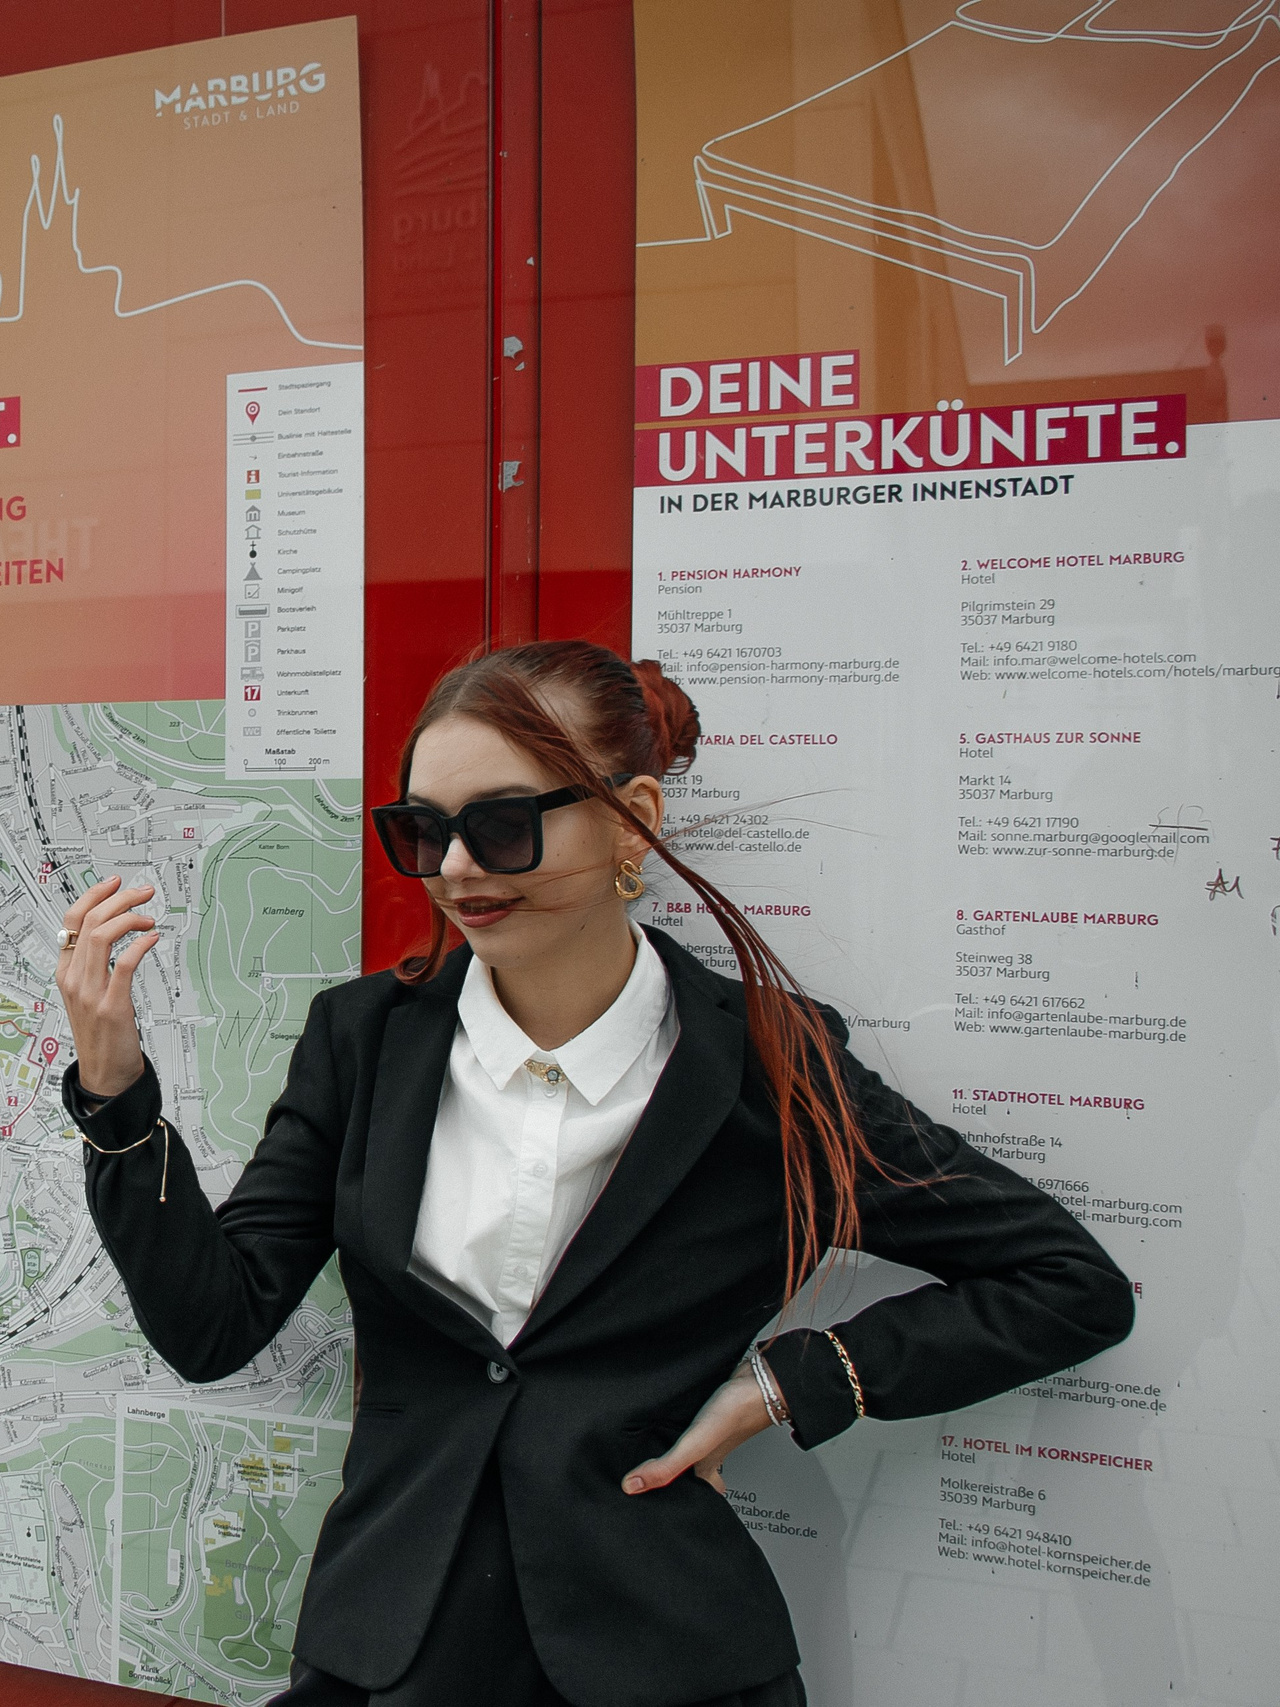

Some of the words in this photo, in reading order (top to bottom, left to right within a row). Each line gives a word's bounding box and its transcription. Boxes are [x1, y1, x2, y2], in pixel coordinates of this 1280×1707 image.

[155, 62, 326, 118] MARBURG
[184, 112, 230, 130] STADT
[239, 111, 247, 121] &
[256, 101, 299, 119] LAND
[278, 380, 331, 391] Stadtspaziergang
[660, 354, 854, 418] DEINE
[317, 428, 351, 436] Haltestelle
[658, 399, 1179, 481] UNTERKÜNFTE.
[278, 469, 338, 478] Tourist-Information
[278, 487, 343, 498] Universitätsgebäude
[660, 495, 682, 514] IN
[692, 492, 738, 512] DER
[748, 485, 902, 510] MARBURGER
[912, 475, 1074, 500] INNENSTADT
[278, 528, 316, 536] Schutzhütte
[961, 560, 971, 571] 2.
[977, 557, 1051, 569] WELCOME
[1056, 555, 1104, 567] HOTEL
[1109, 552, 1184, 565] MARBURG
[278, 566, 321, 575] Campingplatz
[658, 572, 666, 581] 1.
[671, 569, 728, 581] PENSION
[733, 566, 801, 579] HARMONY
[962, 573, 995, 584] Hotel
[277, 586, 303, 595] Minigolf
[658, 585, 702, 594] Pension
[277, 605, 316, 613] Bootsverleih
[961, 601, 1035, 614] Pilgrimstein
[1040, 599, 1055, 610] 29
[658, 610, 724, 621] Mühltreppe
[961, 615, 997, 626] 35037
[1002, 613, 1055, 626] Marburg
[658, 623, 690, 633] 35037
[694, 622, 742, 634] Marburg
[989, 642, 1011, 652] +49
[1016, 641, 1043, 652] 6421
[1048, 640, 1077, 651] 9180
[683, 649, 703, 659] +49
[707, 648, 731, 658] 6421
[736, 647, 781, 658] 1670703
[961, 656, 988, 666] Mail:
[994, 652, 1196, 666] info.mar@welcome-hotels.com
[687, 658, 899, 673] info@pension-harmony-marburg.de
[277, 669, 341, 677] Wohnmobilstellplatz
[688, 671, 899, 686] www.pension-harmony-marburg.de
[960, 670, 990, 680] Web:
[245, 687, 260, 699] 17
[277, 728, 310, 736] öffentliche
[959, 733, 970, 744] 5.
[975, 733, 1050, 744] GASTHAUS
[1056, 732, 1084, 743] ZUR
[1089, 732, 1141, 743] SONNE
[699, 735, 734, 745] TARIA
[740, 735, 764, 745] DEL
[769, 734, 838, 745] CASTELLO
[960, 747, 993, 758] Hotel
[692, 775, 703, 785] 19
[959, 775, 994, 786] Markt
[999, 775, 1011, 785] 14
[692, 788, 740, 801] Marburg
[959, 789, 995, 799] 35037
[1000, 789, 1053, 802] Marburg
[679, 815, 700, 824] +49
[733, 815, 768, 825] 24302
[987, 817, 1009, 827] +49
[1013, 817, 1041, 827] 6421
[1046, 817, 1079, 828] 17190
[959, 830, 986, 841] Mail:
[684, 841, 802, 852] www.del-castello.de
[958, 844, 988, 855] Web:
[993, 845, 1174, 860] www.zur-sonne-marburg.de
[262, 907, 304, 917] Klamberg
[652, 902, 661, 912] 7.
[667, 902, 691, 913] B&B
[744, 905, 811, 916] MARBURG
[653, 915, 683, 926] Hotel
[956, 909, 967, 920] 8.
[973, 910, 1078, 923] GARTENLAUBE
[1084, 913, 1158, 926] MARBURG
[956, 924, 1006, 935] Gasthof
[956, 952, 1013, 967] Steinweg
[1018, 954, 1032, 964] 38
[956, 966, 992, 977] 35037
[997, 967, 1050, 982] Marburg
[983, 995, 1006, 1005] +49
[1010, 995, 1037, 1007] 6421
[1042, 997, 1085, 1009] 617662
[955, 1008, 983, 1018] Mail:
[988, 1008, 1186, 1029] info@gartenlaube-marburg.de
[954, 1021, 984, 1032] Web:
[989, 1025, 1186, 1044] www.gartenlaube-marburg.de
[952, 1089, 967, 1099] 11.
[972, 1089, 1065, 1105] STADTHOTEL
[1070, 1096, 1144, 1110] MARBURG
[953, 1103, 986, 1115] Hotel
[993, 1148, 1045, 1164] Marburg
[1038, 1178, 1089, 1192] 6971666
[127, 1407, 165, 1418] Lahnberge
[942, 1436, 958, 1447] 17.
[964, 1438, 1010, 1454] HOTEL
[1016, 1444, 1032, 1456] IM
[1038, 1447, 1153, 1472] KORNSPEICHER
[942, 1450, 975, 1463] Hotel
[940, 1477, 1034, 1499] Molkereistraße
[940, 1491, 977, 1505] 35039
[982, 1496, 1036, 1516] Marburg
[968, 1524, 990, 1534] +49
[994, 1526, 1021, 1539] 6421
[1026, 1530, 1072, 1546] 948410
[939, 1532, 966, 1545] Mail:
[971, 1537, 1151, 1572] info@hotel-kornspeicher.de
[938, 1546, 968, 1559] Web:
[973, 1551, 1151, 1586] www.hotel-kornspeicher.de
